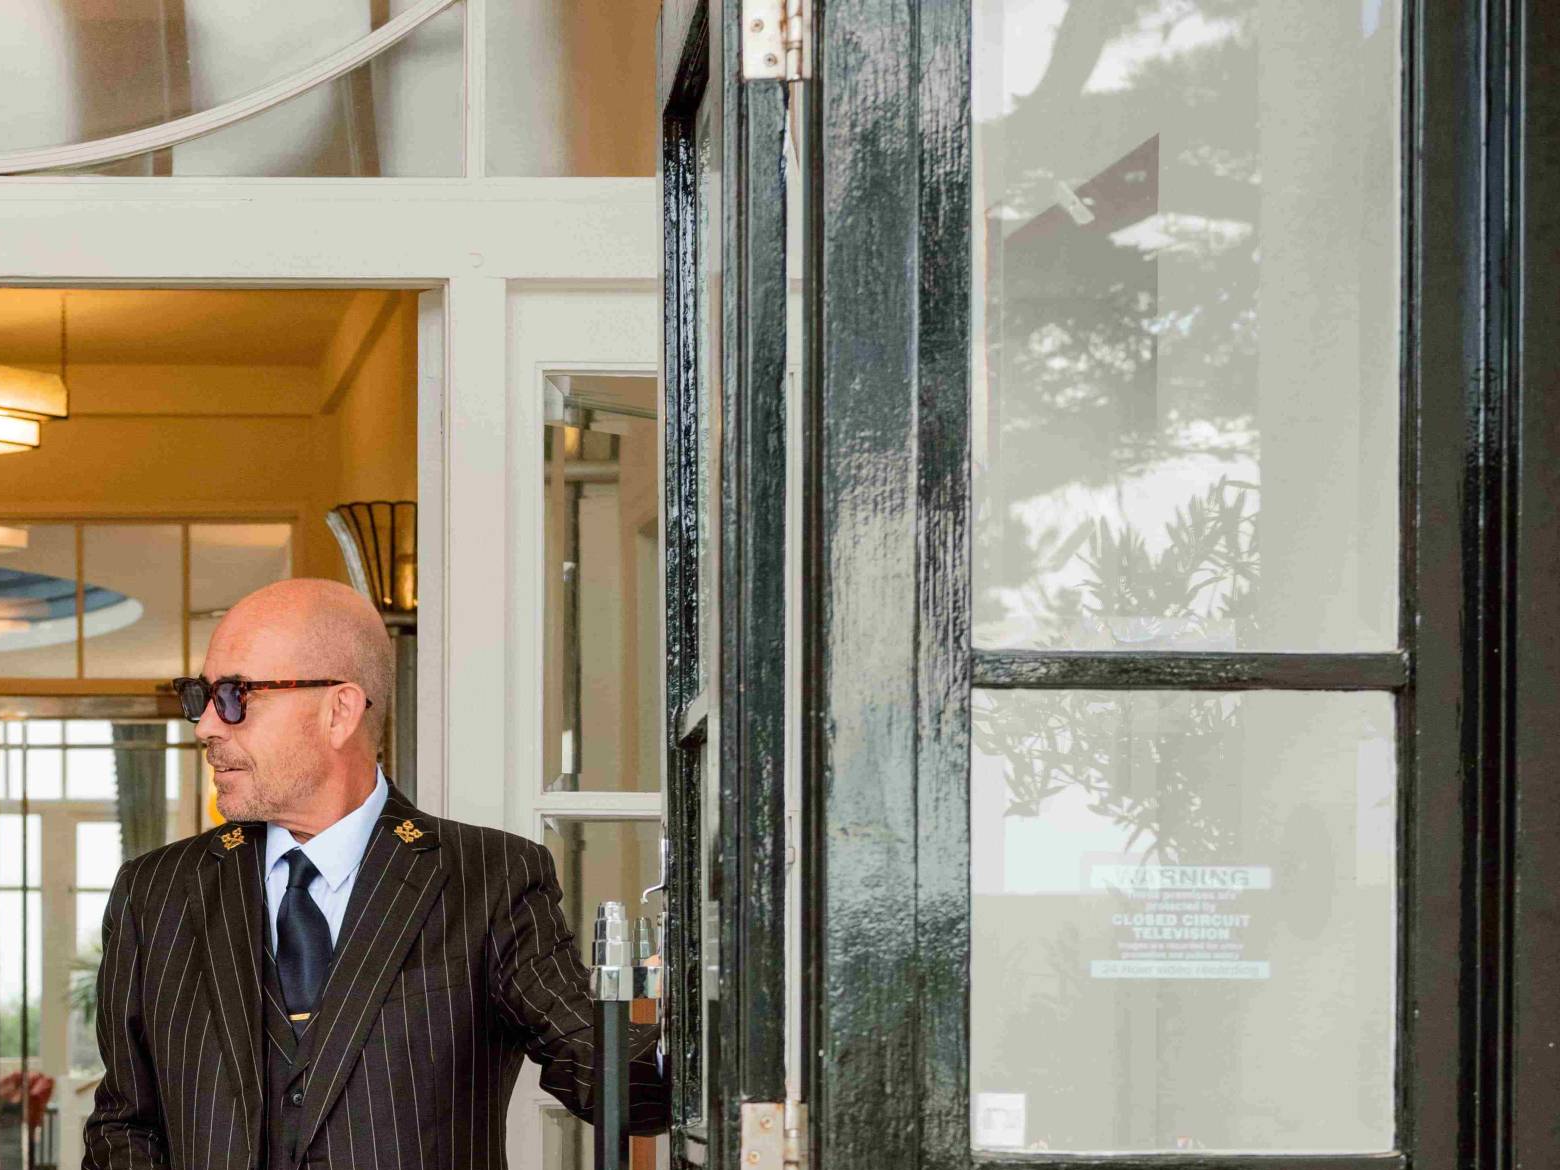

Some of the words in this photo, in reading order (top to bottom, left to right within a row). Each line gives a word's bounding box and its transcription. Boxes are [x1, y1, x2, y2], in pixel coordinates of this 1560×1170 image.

[1111, 913, 1178, 926] CLOSED
[1182, 913, 1251, 928] CIRCUIT
[1132, 927, 1230, 940] TELEVISION
